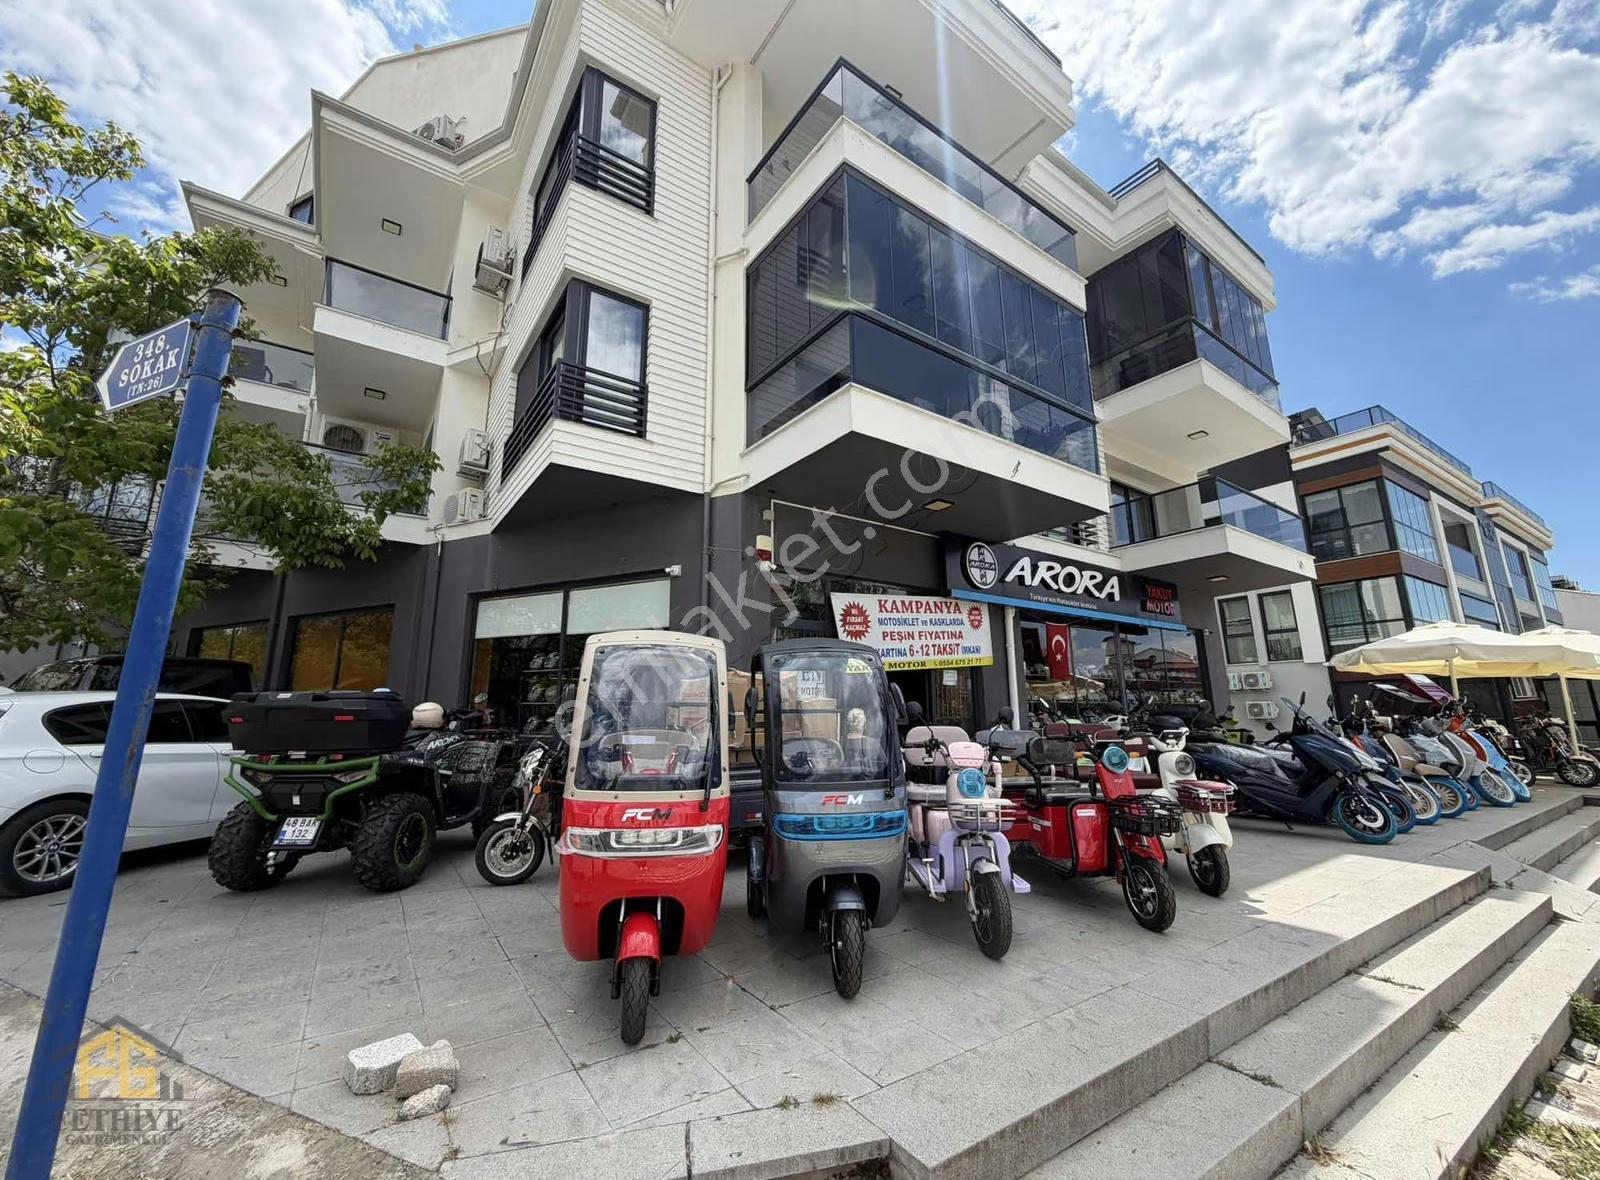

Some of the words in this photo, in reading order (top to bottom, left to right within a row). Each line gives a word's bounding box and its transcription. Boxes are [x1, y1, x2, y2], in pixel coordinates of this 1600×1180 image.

[119, 348, 180, 387] SOKAK
[127, 374, 164, 400] (TN:26)
[1004, 556, 1120, 601] ARORA
[877, 599, 962, 614] KAMPANYA
[1146, 600, 1176, 616] MOTOR
[929, 616, 965, 626] KASKLARDA
[888, 661, 927, 670] MOTOR
[822, 794, 864, 806] FCM
[621, 808, 672, 822] FCM
[291, 829, 309, 838] 132
